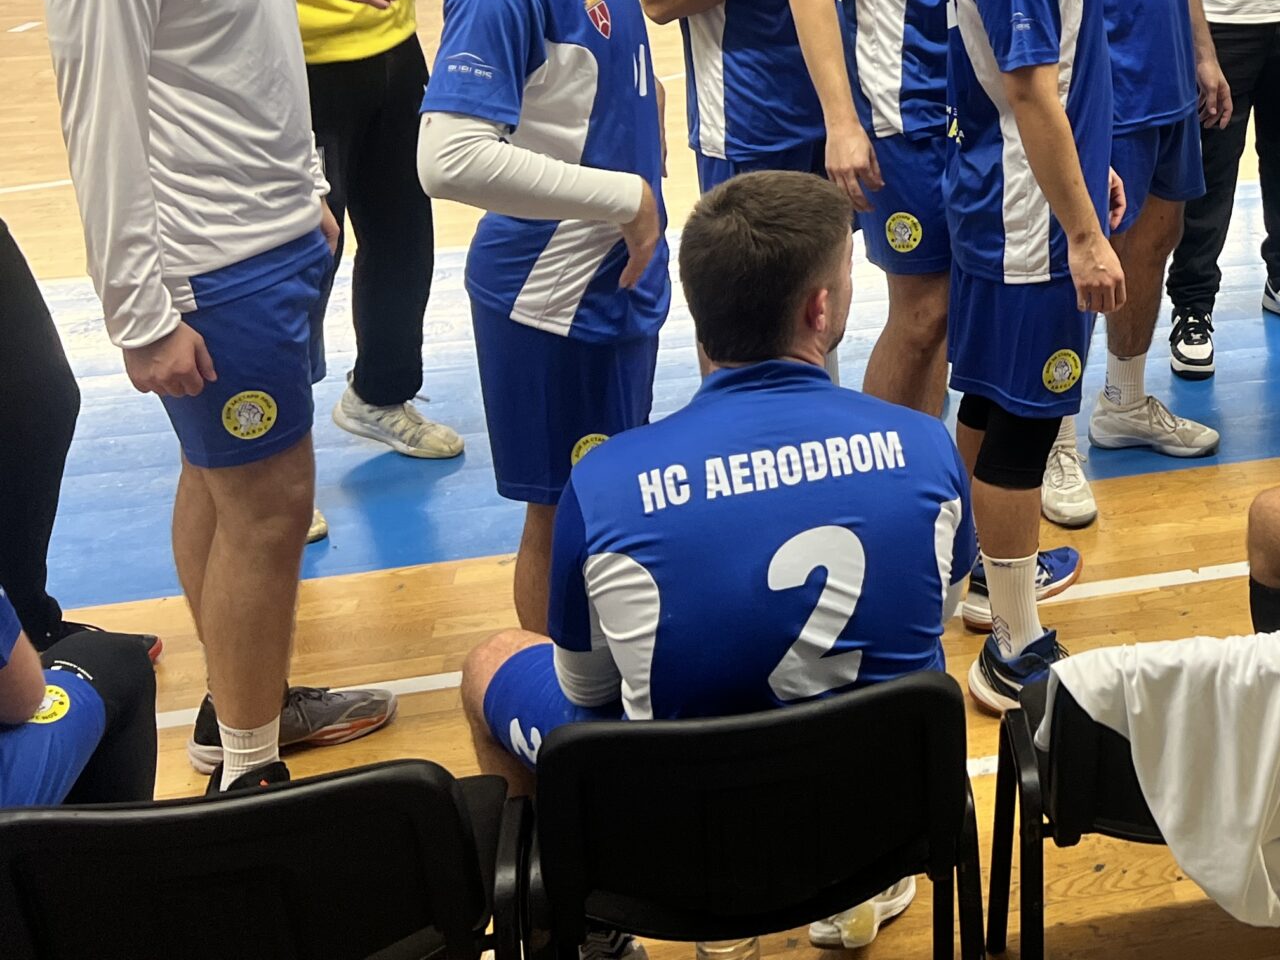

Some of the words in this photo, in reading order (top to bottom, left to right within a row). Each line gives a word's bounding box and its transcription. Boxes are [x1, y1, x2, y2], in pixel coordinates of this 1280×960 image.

[638, 464, 691, 513] HC
[705, 431, 906, 499] AERODROM
[767, 525, 866, 701] 2
